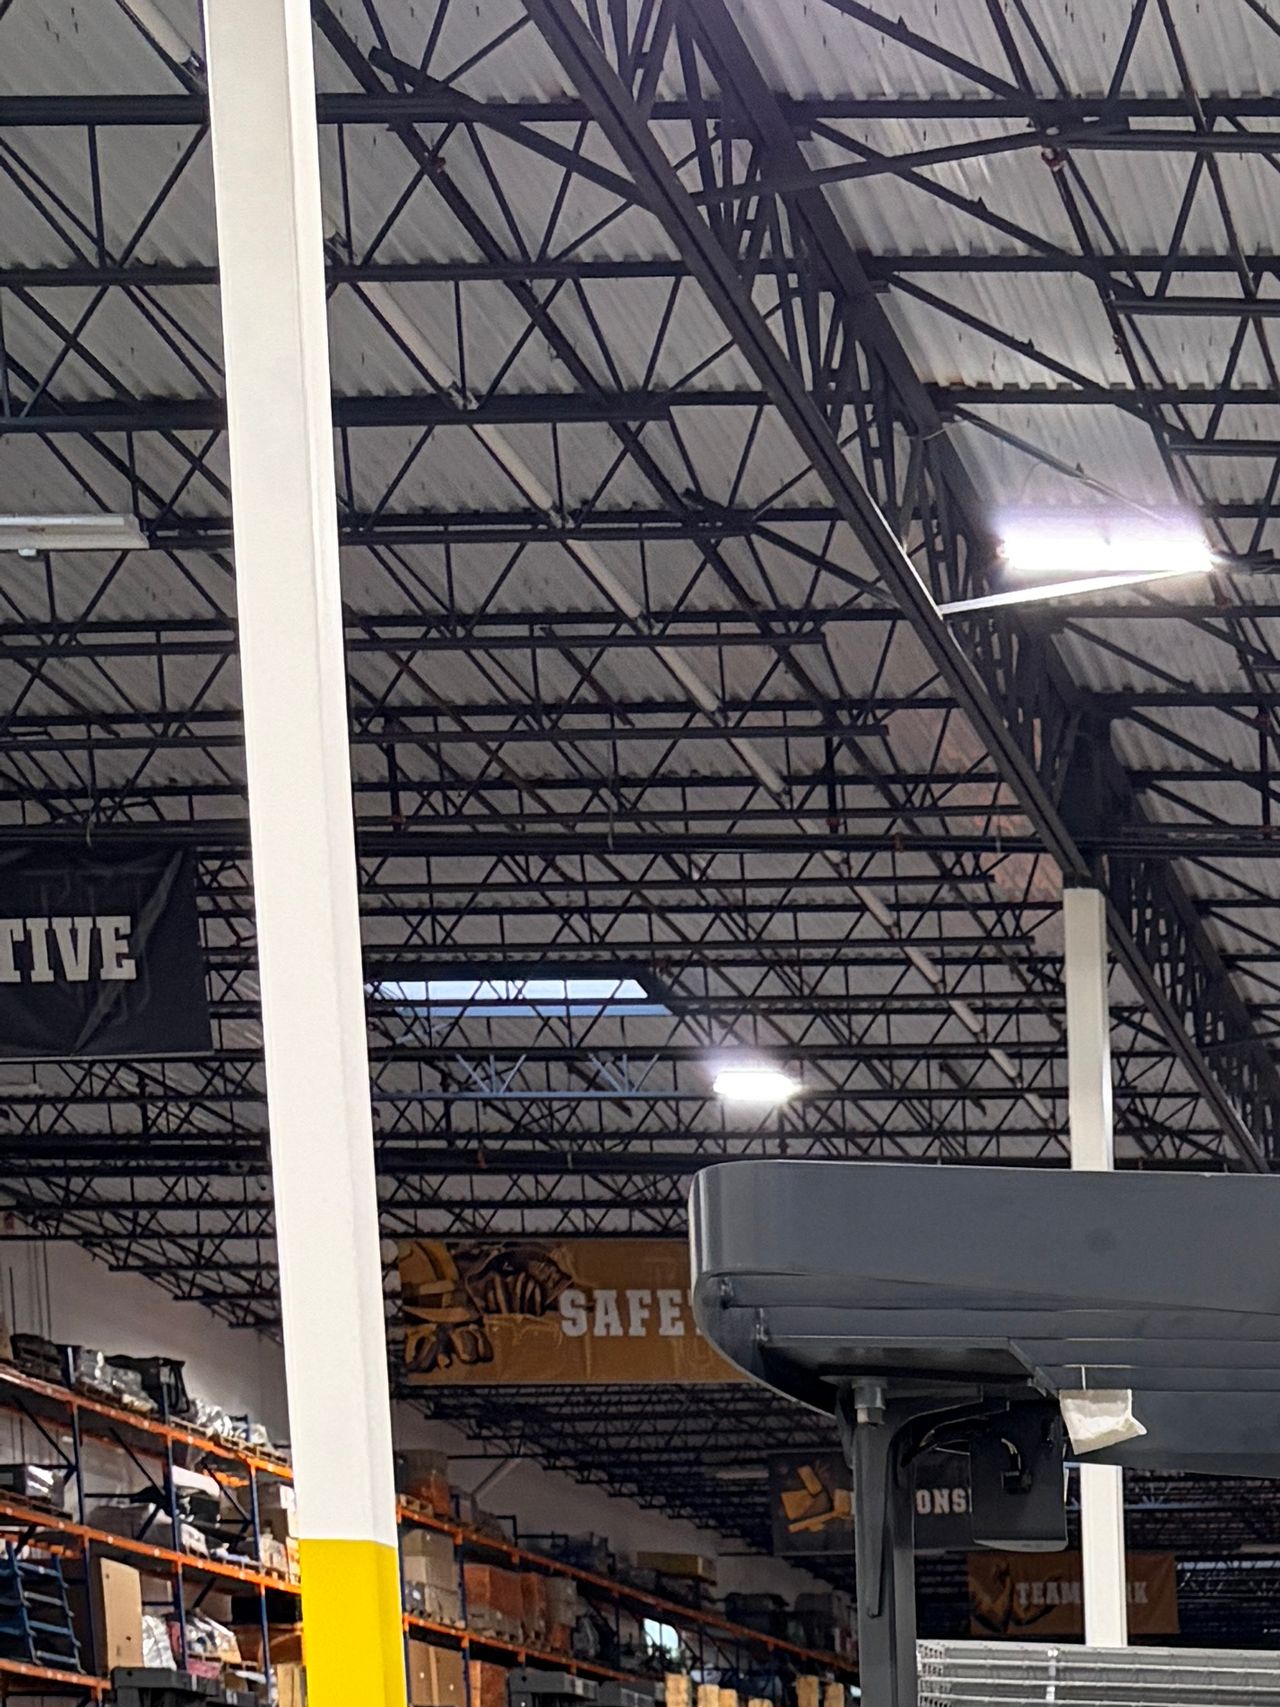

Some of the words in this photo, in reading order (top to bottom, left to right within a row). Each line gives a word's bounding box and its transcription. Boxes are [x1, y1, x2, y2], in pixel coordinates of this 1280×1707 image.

[0, 916, 136, 982] TIVE
[559, 1288, 703, 1337] SAFE
[916, 1488, 972, 1514] ONS
[1015, 1581, 1149, 1607] TEAMK
